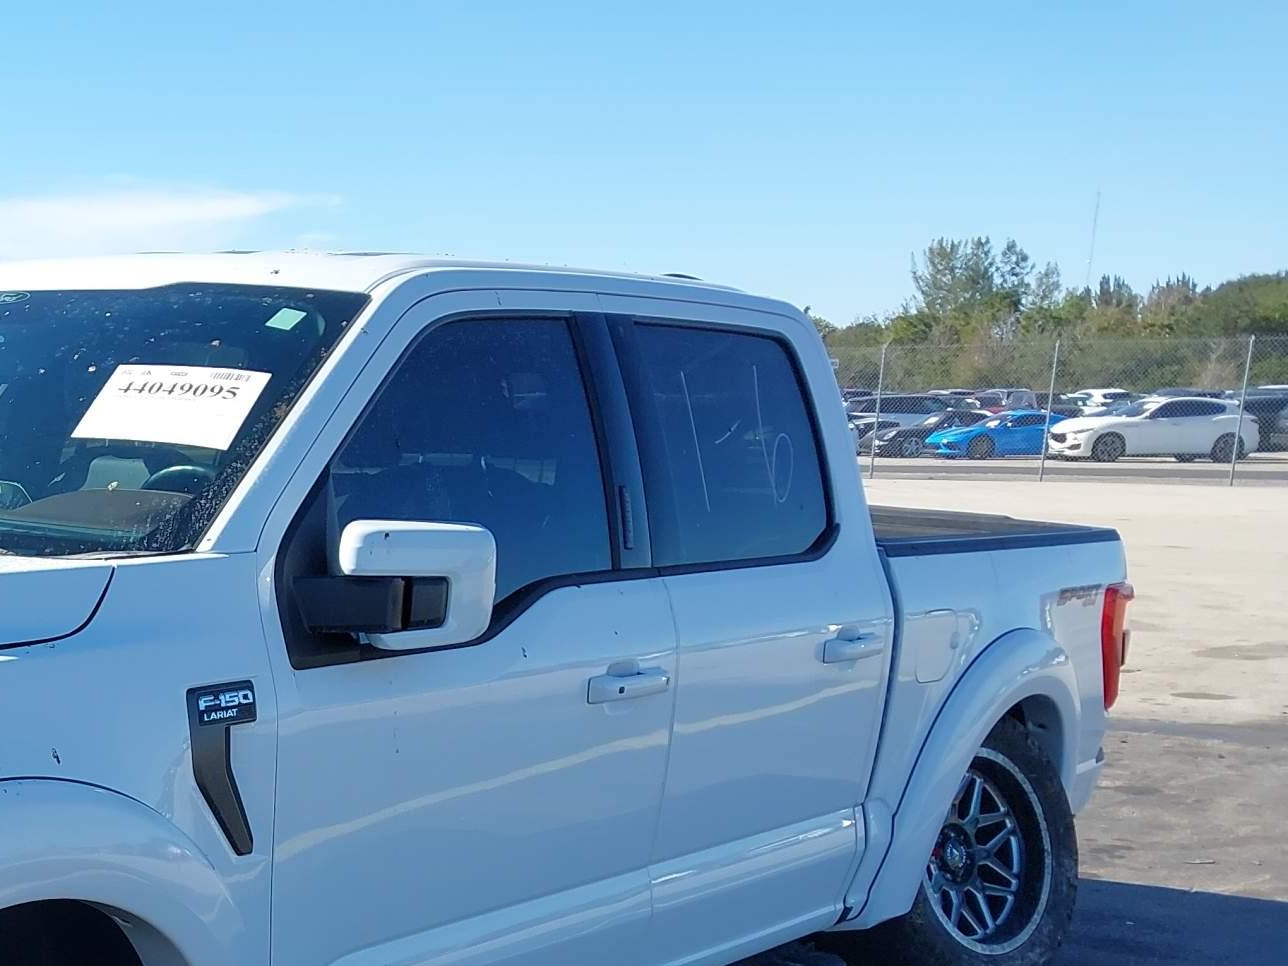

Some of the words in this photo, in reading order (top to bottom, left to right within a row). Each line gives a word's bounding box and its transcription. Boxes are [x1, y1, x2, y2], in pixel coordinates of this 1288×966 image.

[117, 380, 241, 400] 44049095
[198, 689, 254, 711] F-150
[203, 708, 239, 721] LARIAT
